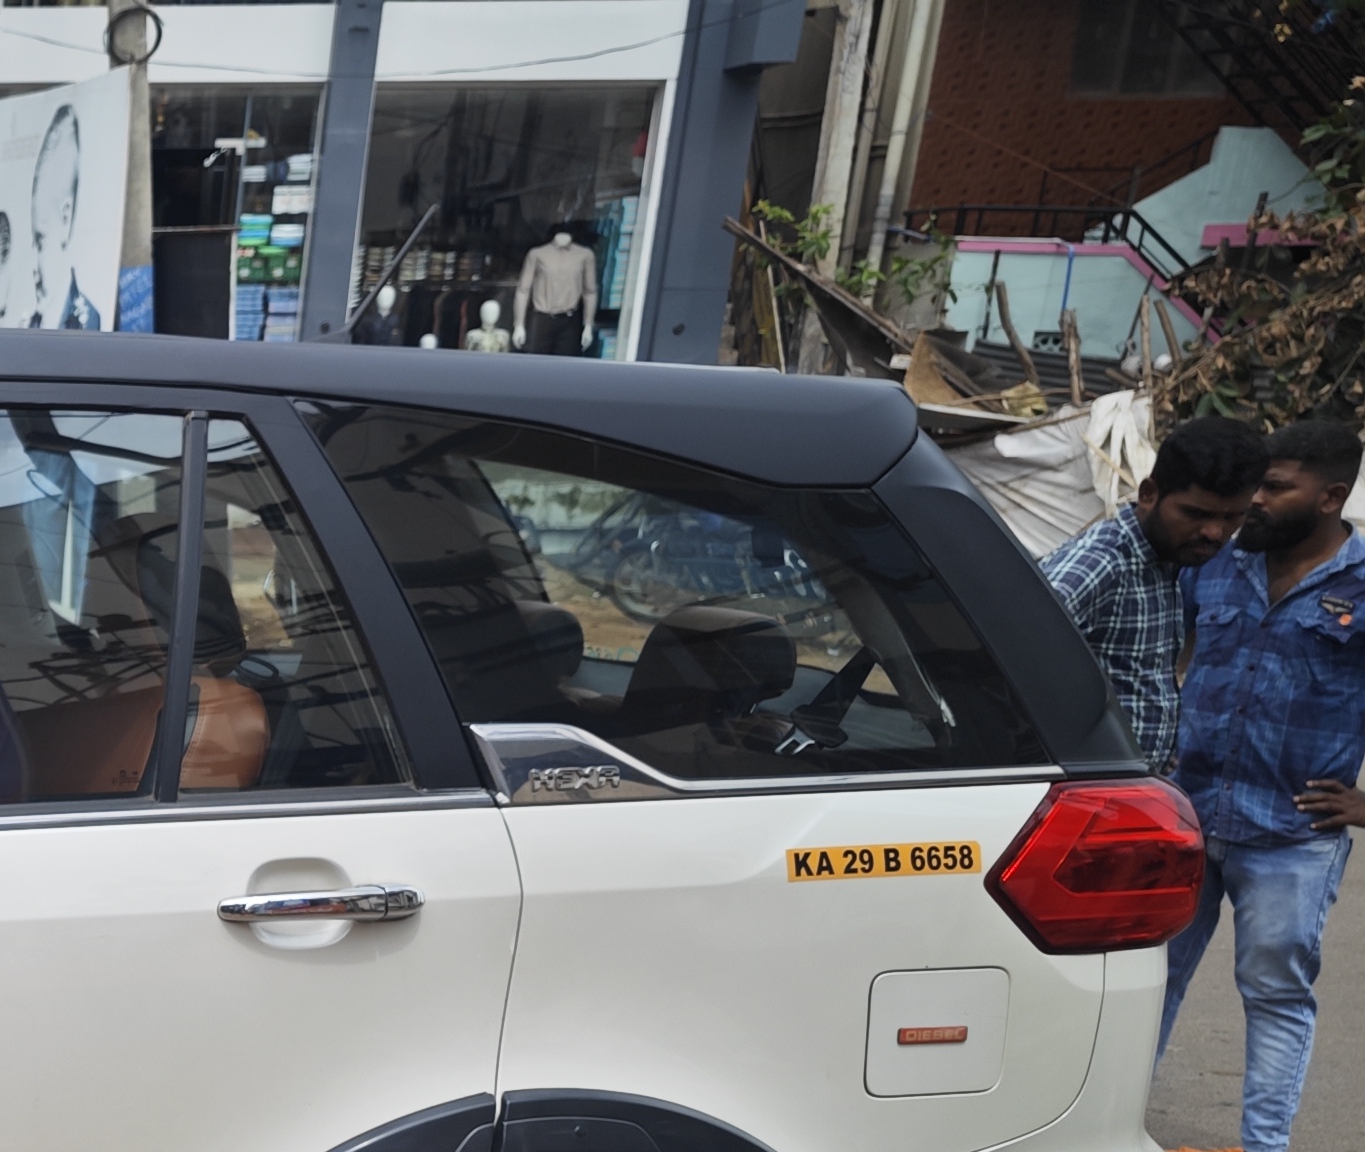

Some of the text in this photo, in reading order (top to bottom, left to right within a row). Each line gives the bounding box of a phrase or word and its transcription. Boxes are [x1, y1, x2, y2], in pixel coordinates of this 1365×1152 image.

[529, 765, 620, 792] HEXA
[794, 845, 973, 877] KA 29 B 6658
[905, 1028, 964, 1041] DIESEL
